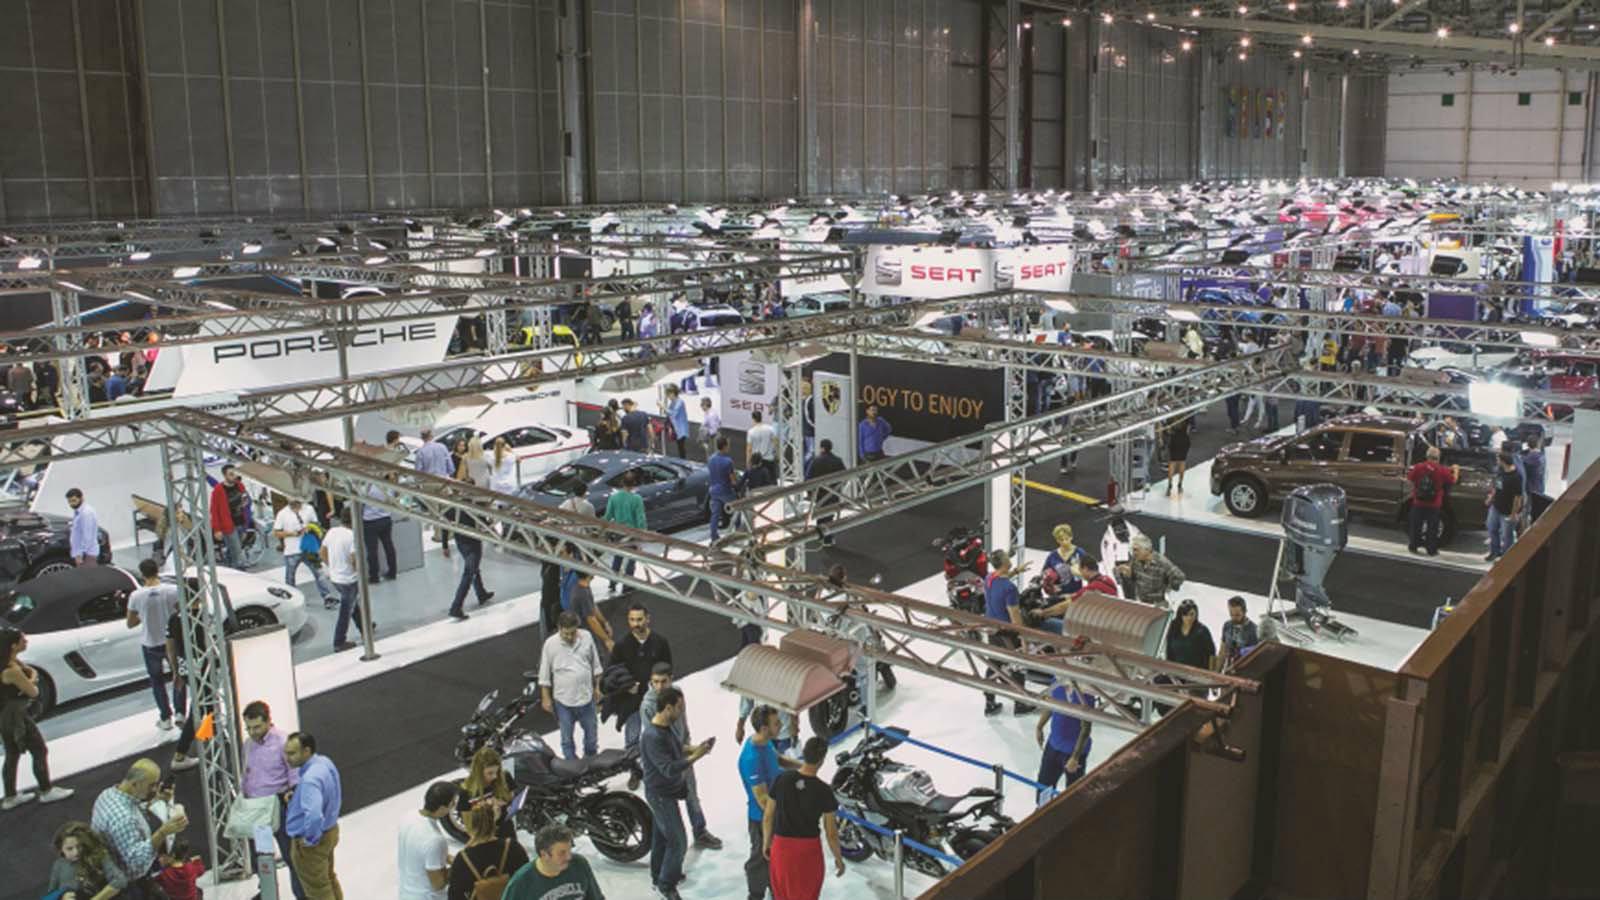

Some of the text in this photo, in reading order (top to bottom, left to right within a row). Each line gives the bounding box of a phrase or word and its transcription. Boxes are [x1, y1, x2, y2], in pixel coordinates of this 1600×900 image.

[911, 264, 982, 283] SEAT
[1020, 262, 1067, 280] SEAT
[901, 390, 923, 412] TO
[928, 393, 984, 419] ENJOY
